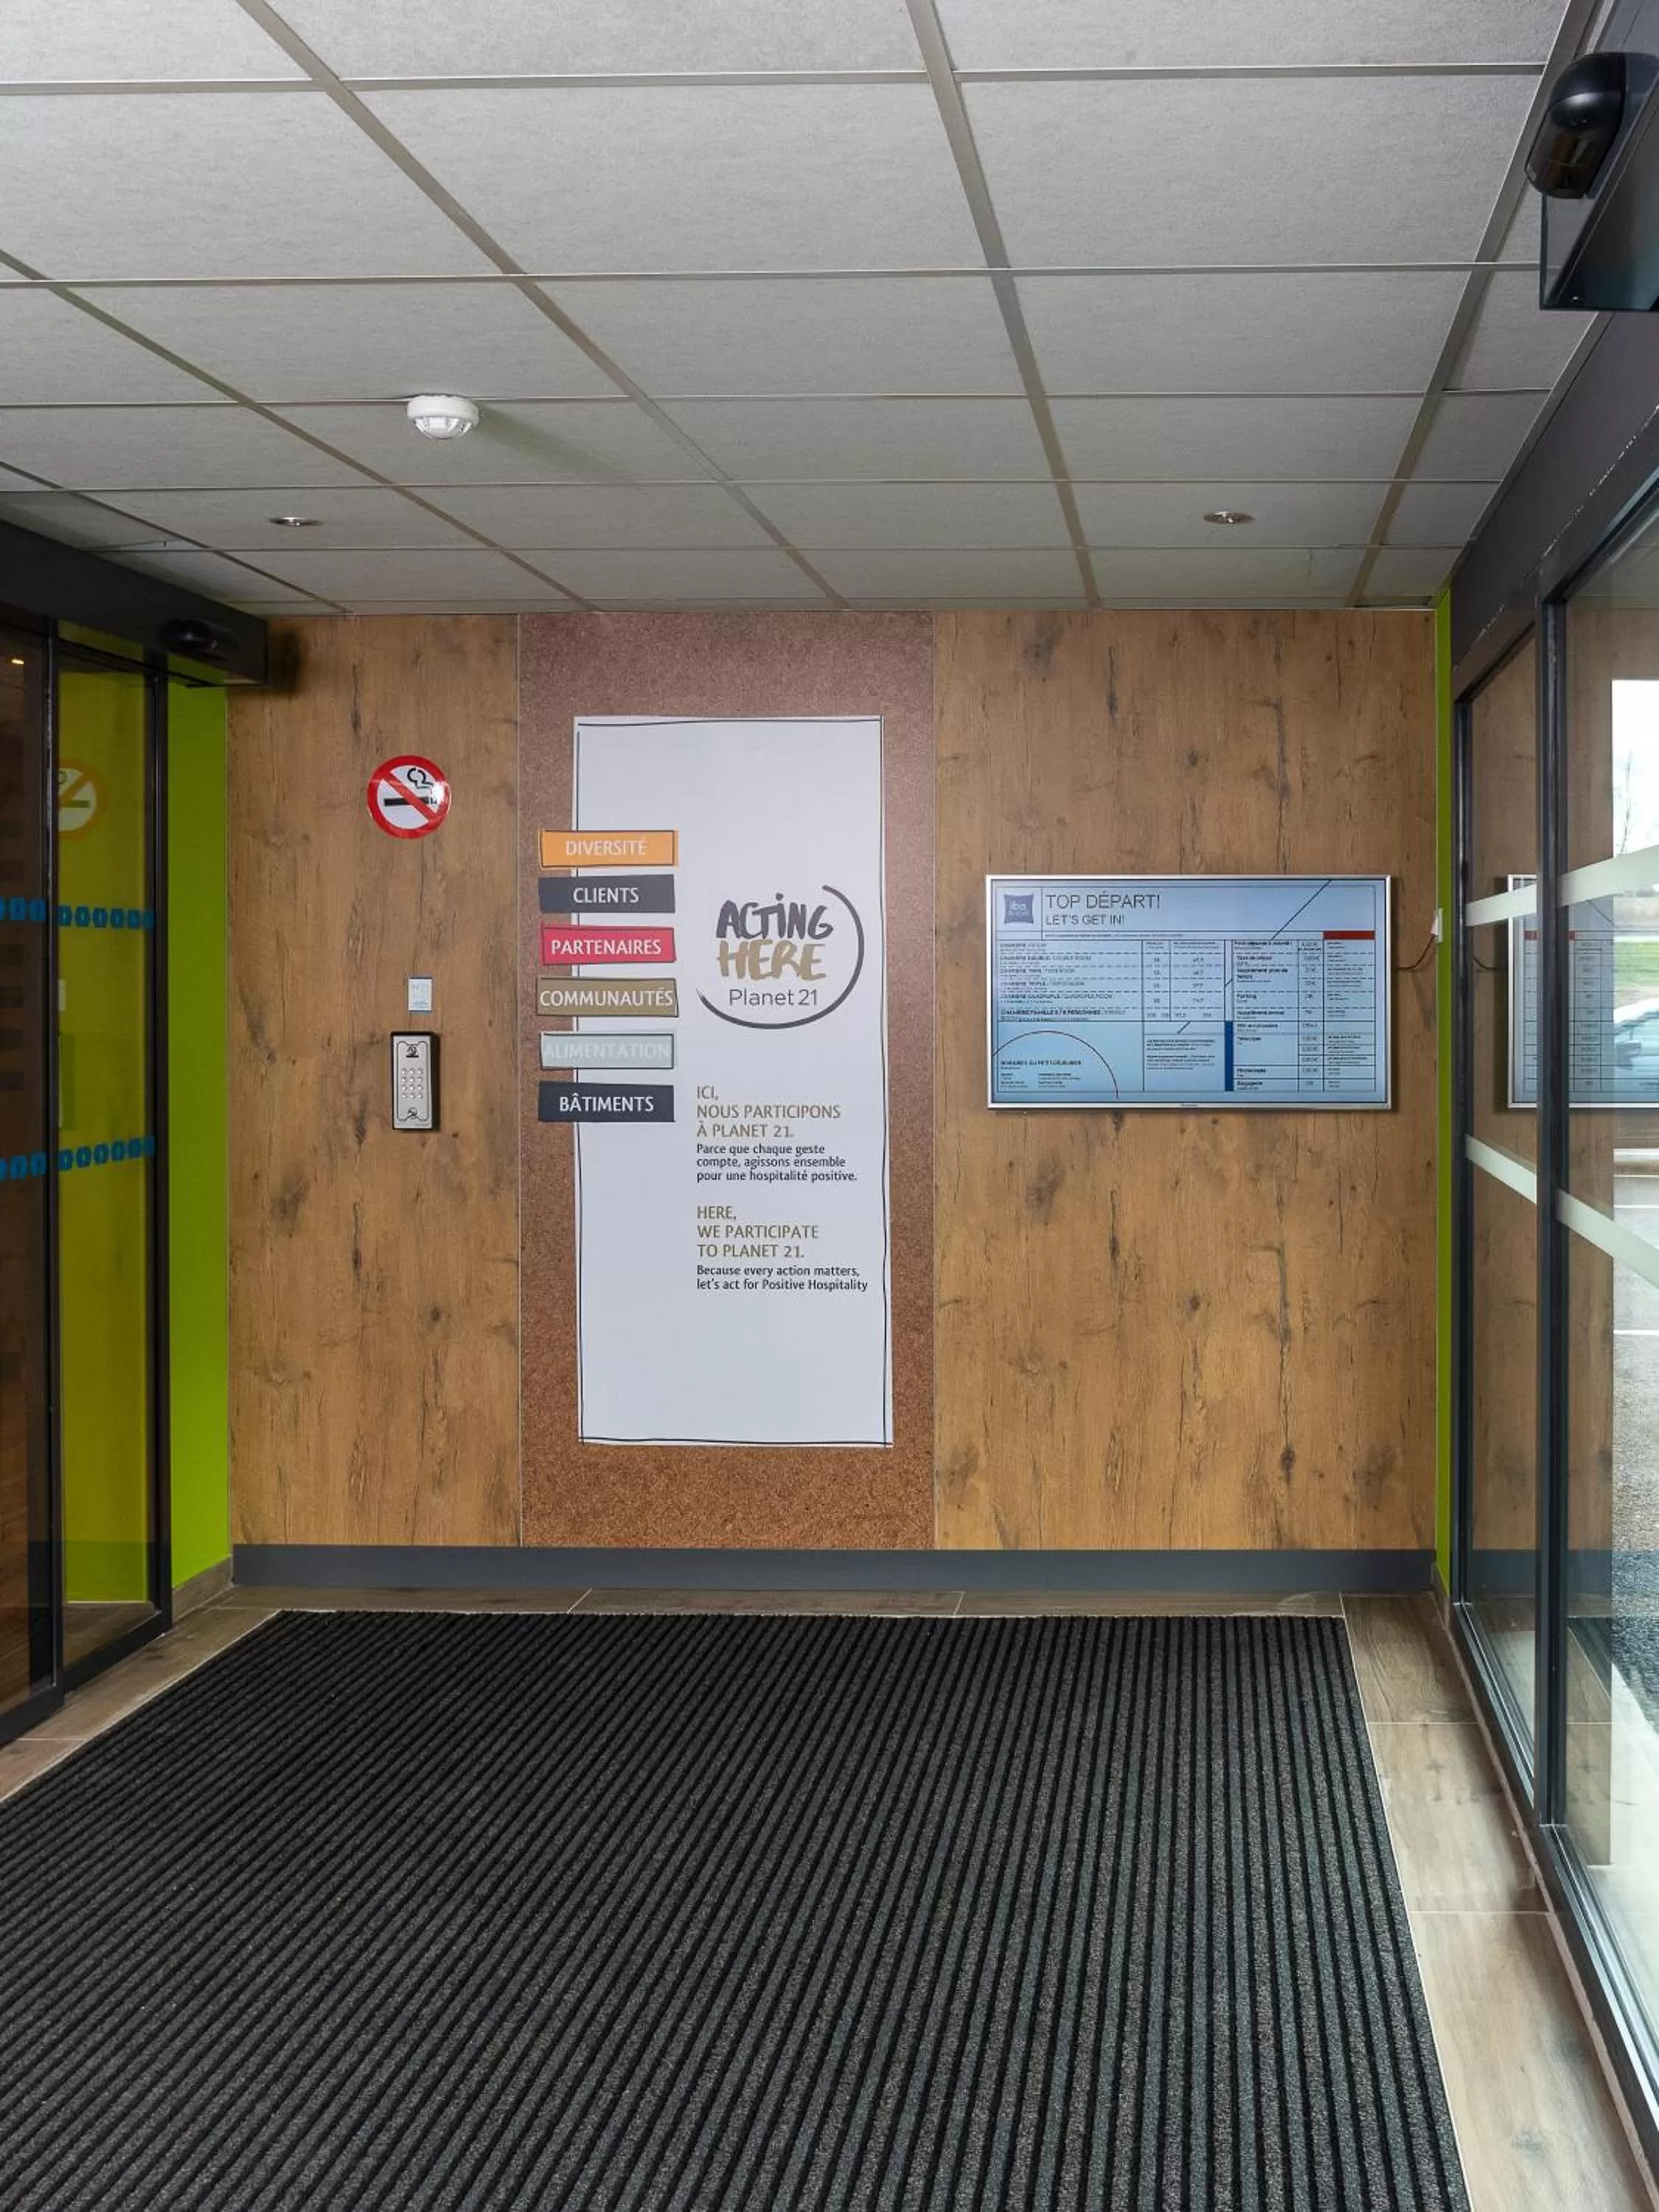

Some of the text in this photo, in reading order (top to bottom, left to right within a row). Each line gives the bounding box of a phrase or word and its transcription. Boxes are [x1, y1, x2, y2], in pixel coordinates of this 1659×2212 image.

[565, 836, 647, 856] DIVERSITÉ
[572, 886, 640, 904] CLIENTS
[1045, 890, 1161, 909] TOP DÉPART!
[1046, 914, 1125, 925] LET'S GET IN!
[551, 939, 662, 956] PARTENAIRES
[716, 939, 827, 981] HERE
[539, 986, 674, 1007] COMMUNAUTÉS
[728, 988, 818, 1006] Planet 21
[543, 1041, 670, 1060] ALIMENTATION
[696, 1085, 720, 1101] ICI,
[559, 1091, 655, 1112] BÂTIMENTS
[697, 1105, 841, 1119] NOUS PARTICIPONS
[696, 1120, 795, 1138] À PLANET 21.
[696, 1143, 825, 1158] Parce que chaque geste
[696, 1156, 846, 1171] compte, agissons ensemble
[696, 1169, 858, 1183] pour une hospitalité positive.
[697, 1206, 737, 1220] HERE,
[697, 1225, 820, 1239] WE PARTICIPATE
[697, 1244, 805, 1259] TO PLANET 21.
[696, 1265, 860, 1279] Because every action matters,
[696, 1278, 869, 1293] let's act for Positive Hospitality
